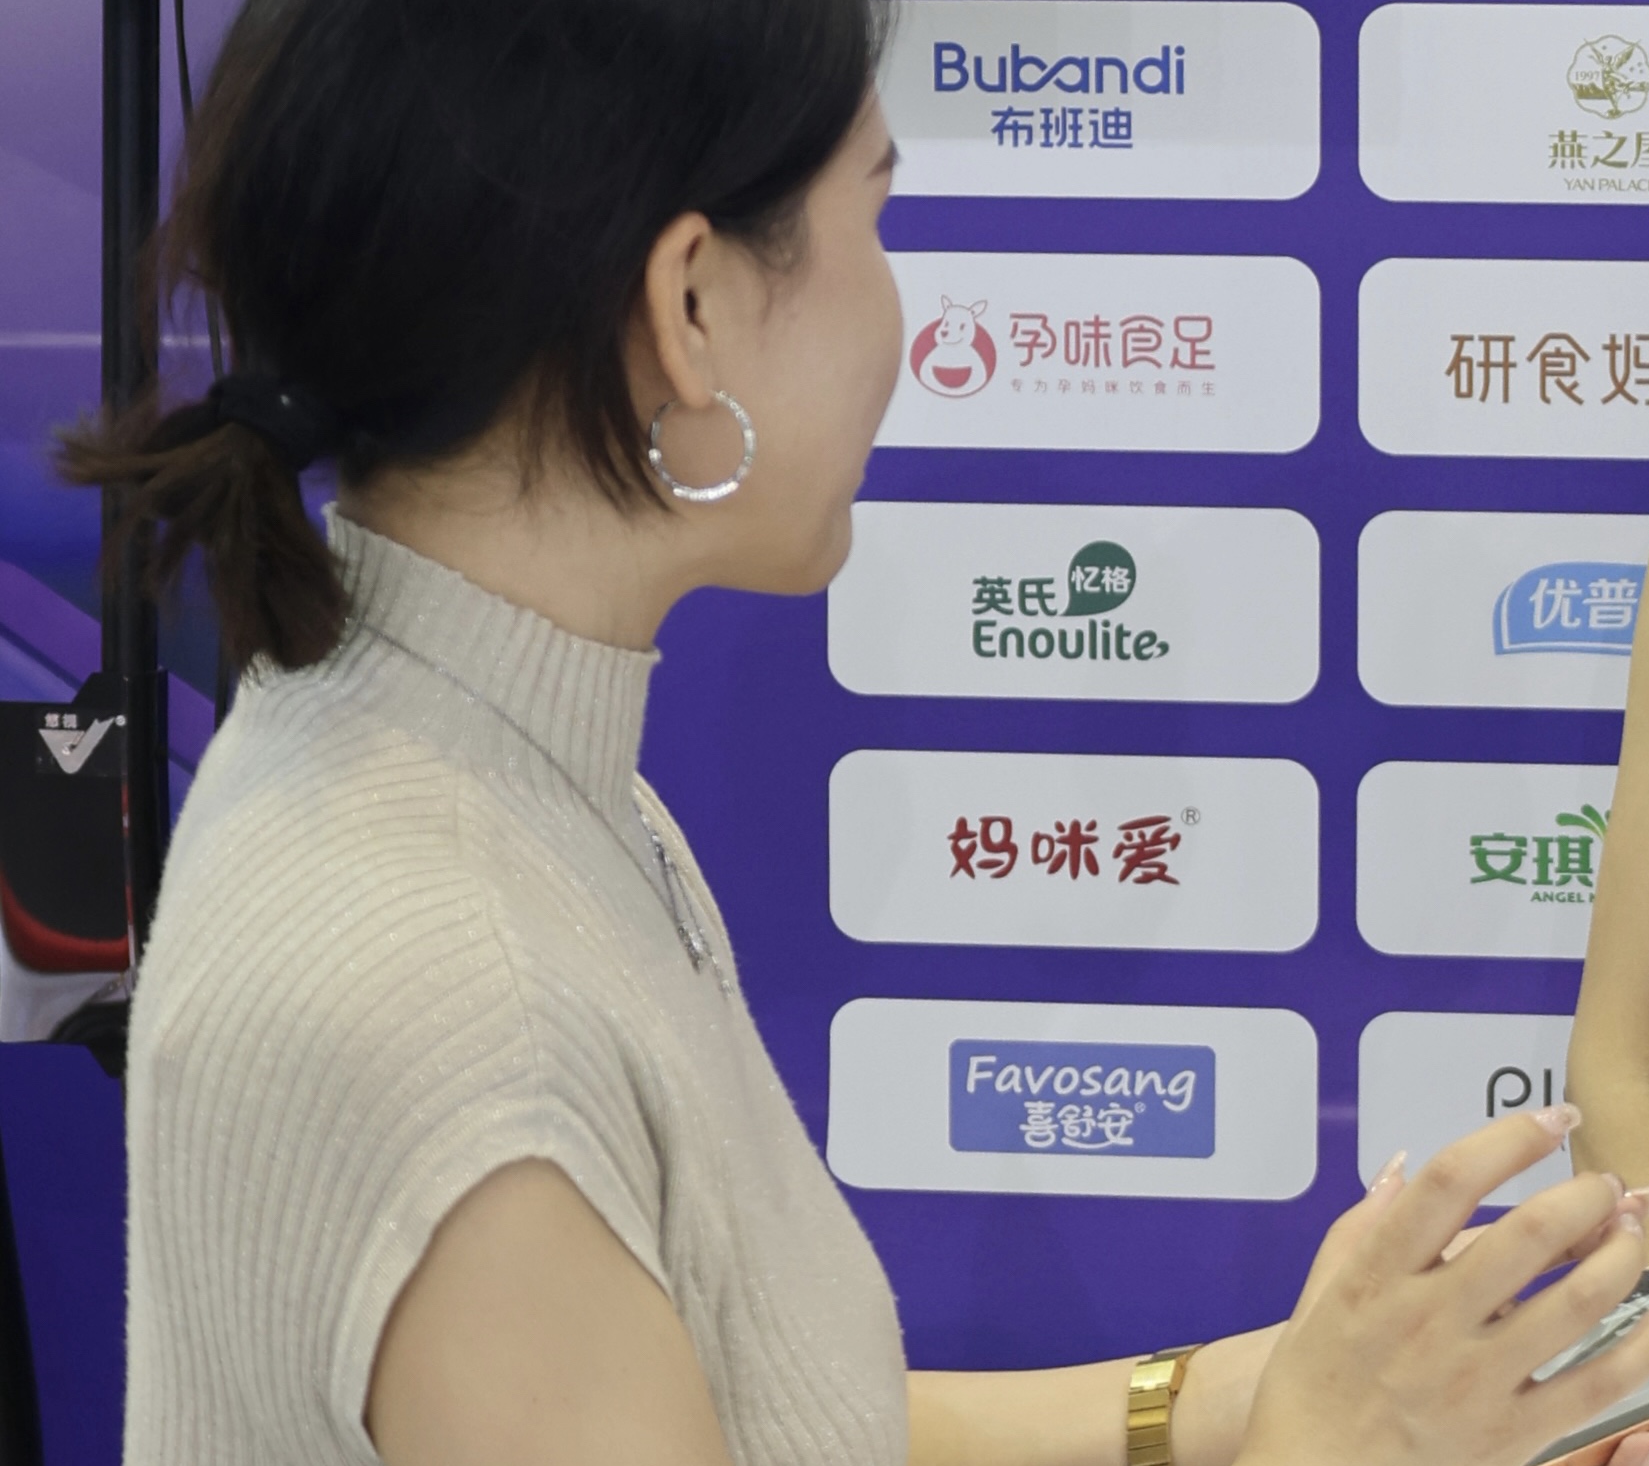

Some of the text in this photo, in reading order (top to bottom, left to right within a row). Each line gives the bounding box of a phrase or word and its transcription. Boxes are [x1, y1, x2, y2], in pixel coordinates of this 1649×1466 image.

[934, 42, 1184, 94] Bubandi
[992, 107, 1132, 148] 布班迪
[1564, 177, 1594, 192] YAN
[1010, 314, 1215, 370] 孕味食足
[971, 565, 1132, 617] 英氏 忆格
[1529, 577, 1639, 630] 优普
[973, 620, 1169, 661] Enoulite
[948, 816, 1180, 885] 妈咪爱
[1466, 831, 1596, 888] 安琪
[1528, 891, 1587, 905] ANGEL
[965, 1054, 1196, 1109] Favosang
[1020, 1102, 1134, 1148] 喜舒安
